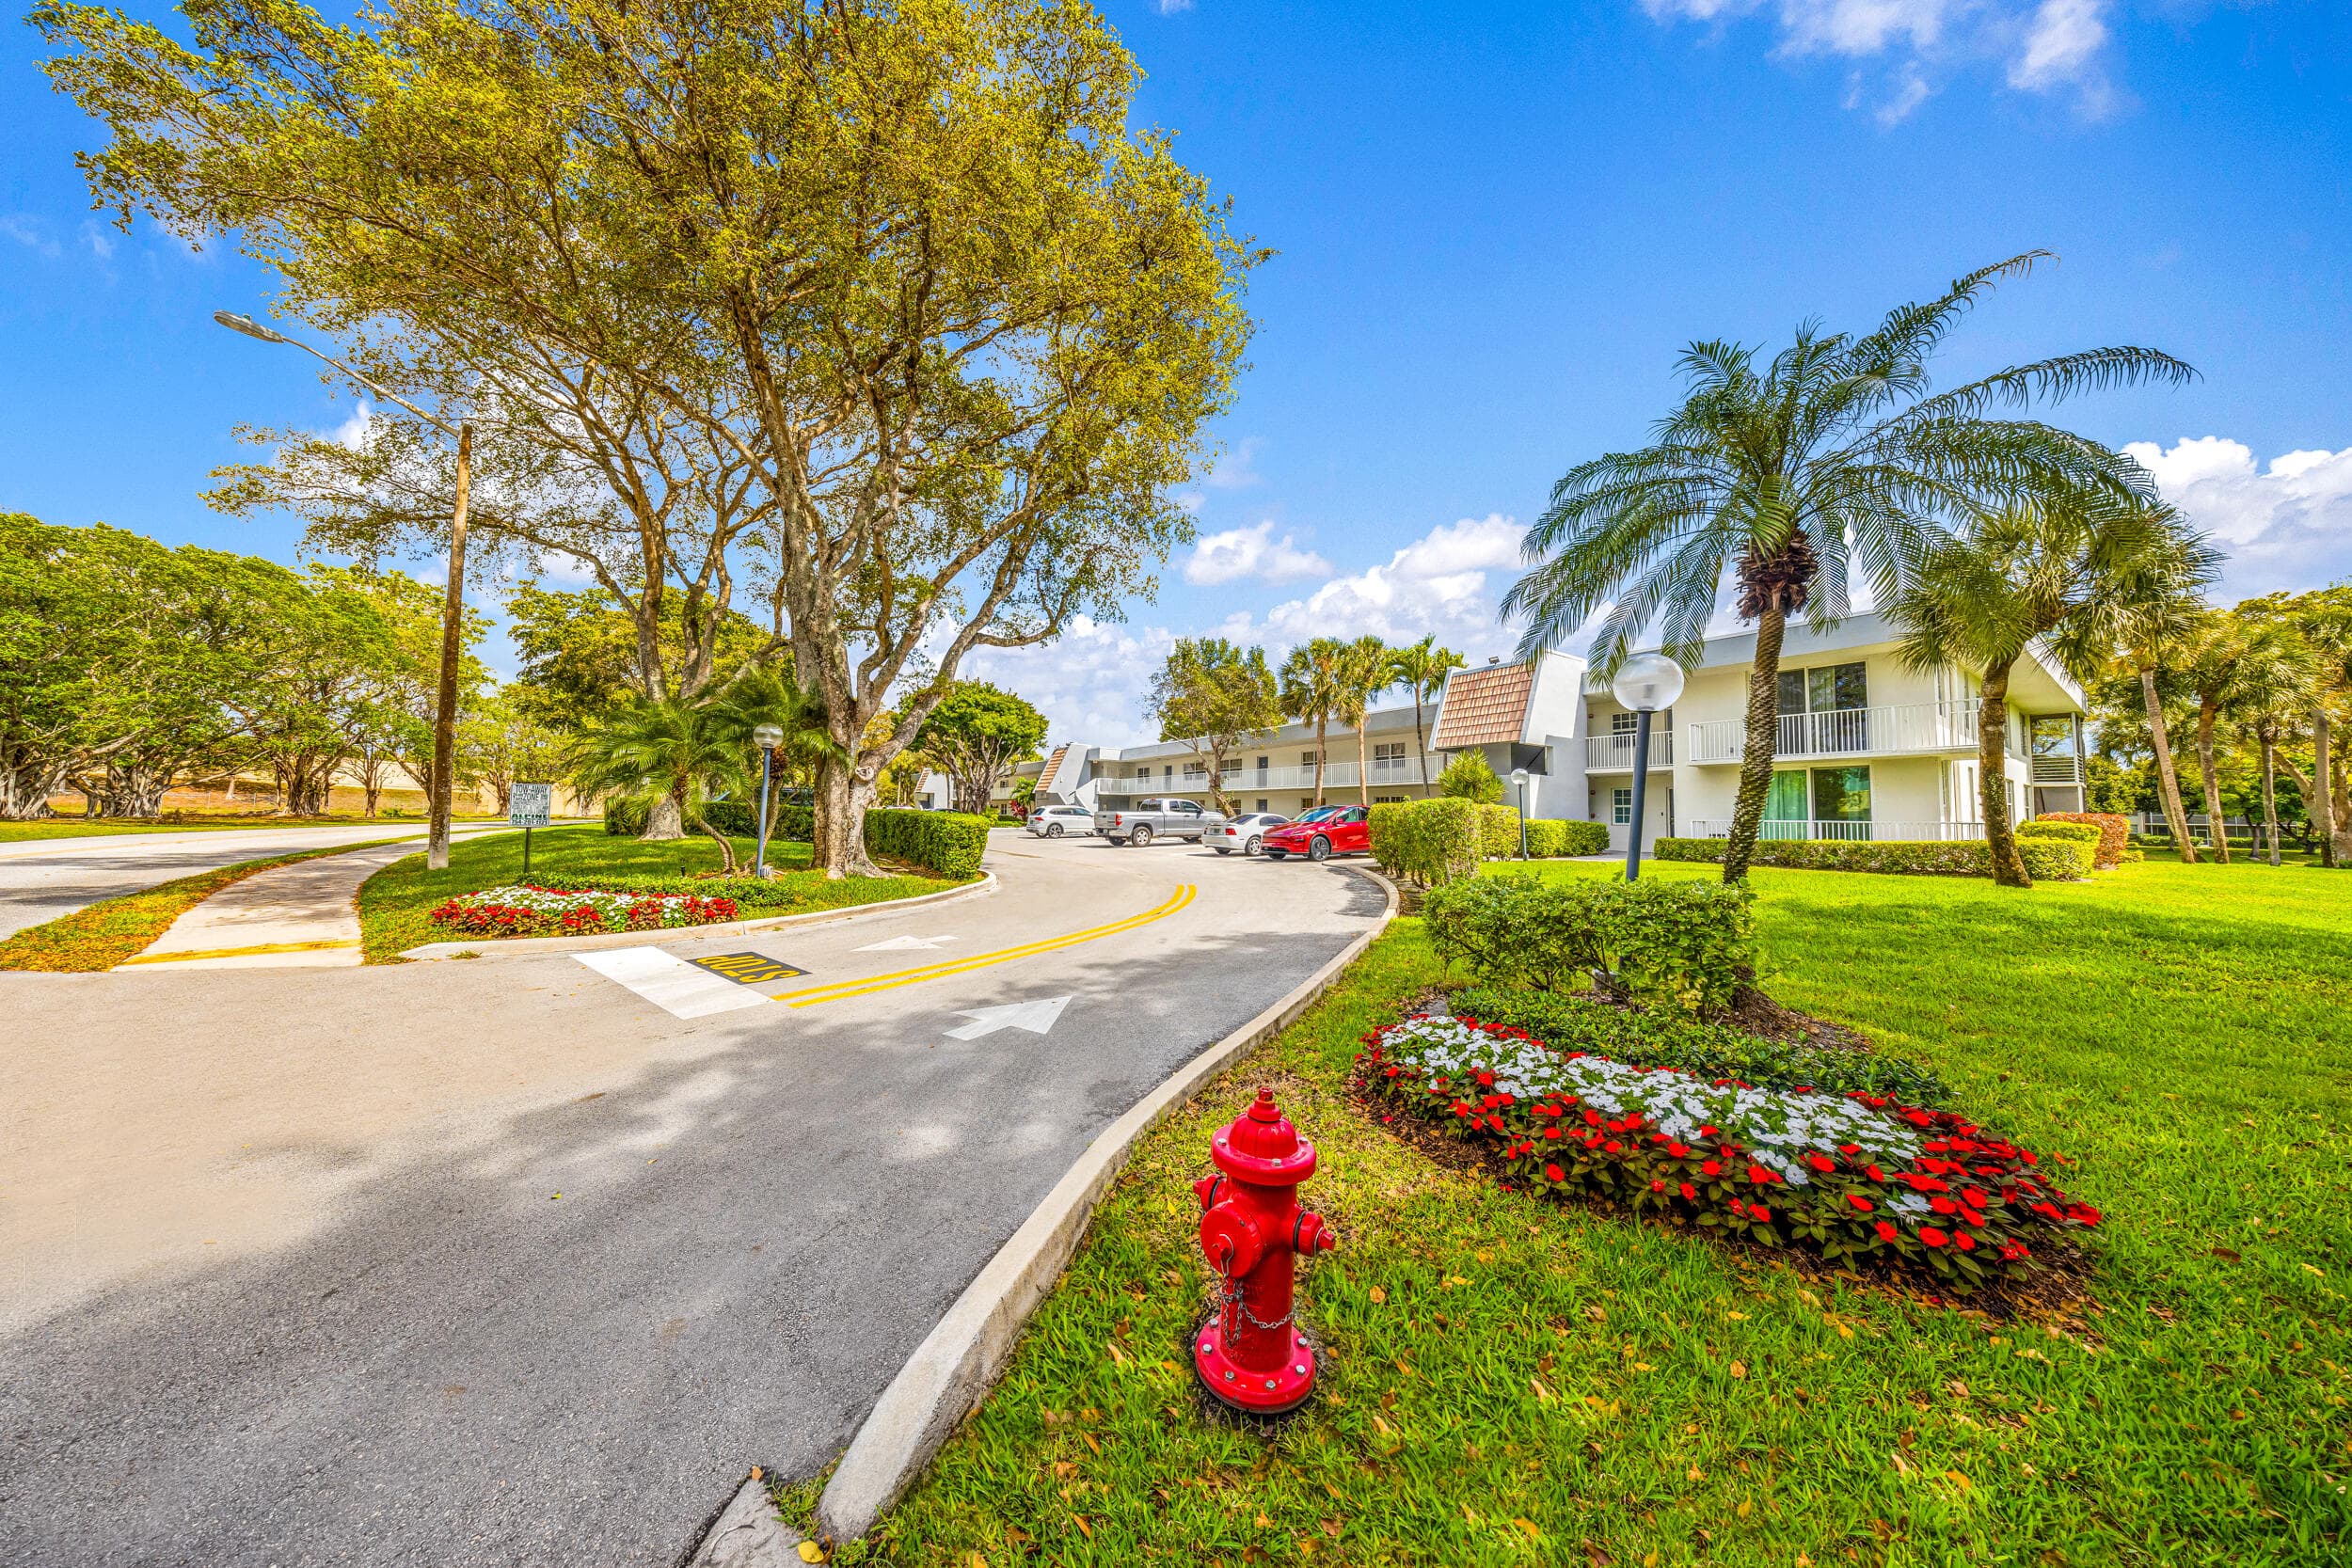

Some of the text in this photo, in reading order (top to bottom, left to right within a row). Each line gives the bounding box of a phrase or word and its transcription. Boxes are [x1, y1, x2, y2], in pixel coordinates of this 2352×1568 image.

[516, 784, 548, 794] TOW-AWAY
[522, 793, 539, 801] ZONE
[696, 955, 800, 983] STOP
